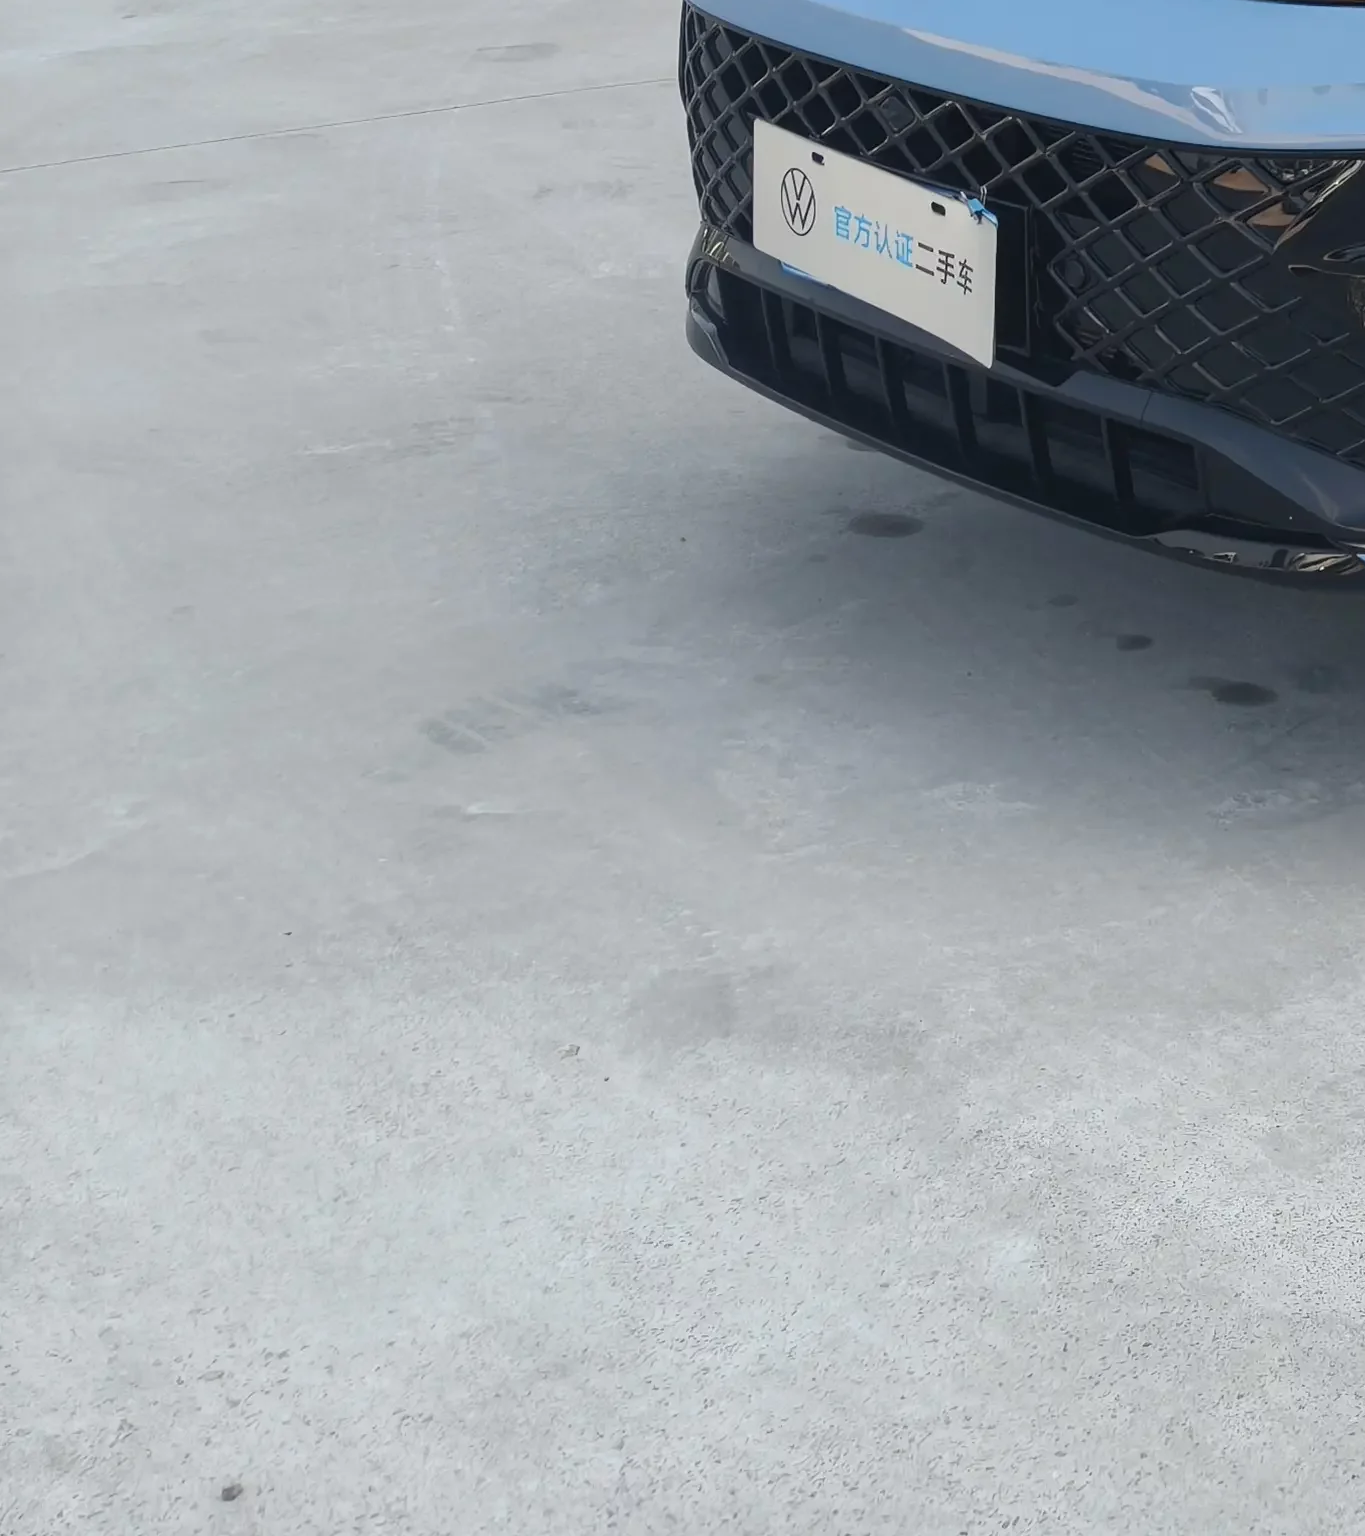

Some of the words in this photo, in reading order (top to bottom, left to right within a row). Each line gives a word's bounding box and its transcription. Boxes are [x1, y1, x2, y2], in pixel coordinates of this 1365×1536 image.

[833, 205, 974, 295] 官方认证二手车
